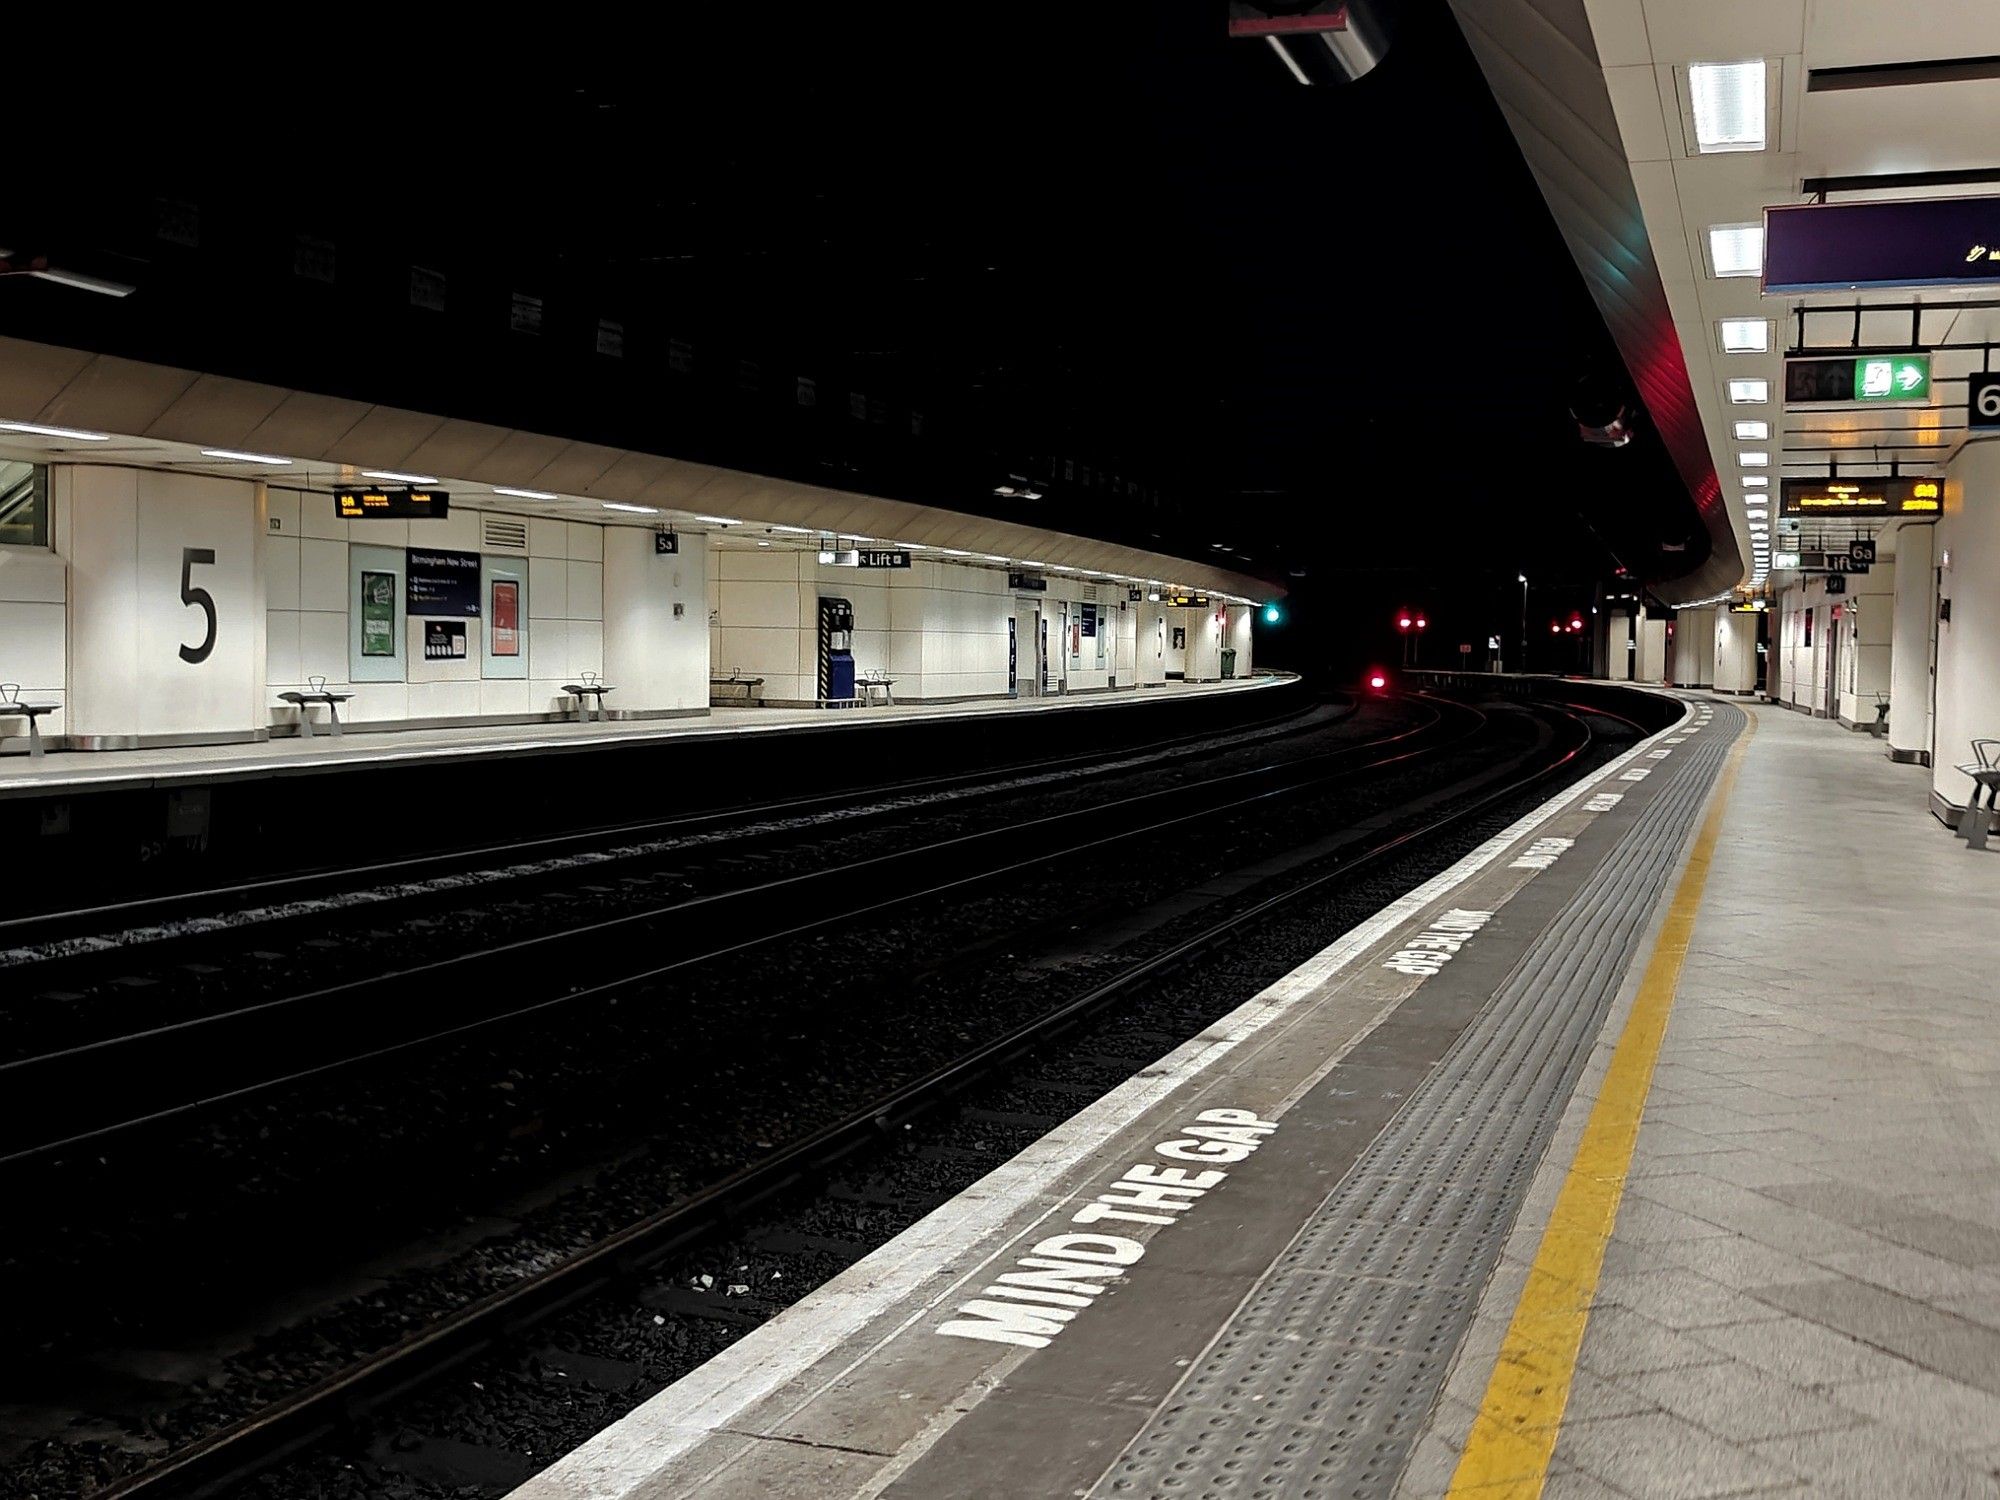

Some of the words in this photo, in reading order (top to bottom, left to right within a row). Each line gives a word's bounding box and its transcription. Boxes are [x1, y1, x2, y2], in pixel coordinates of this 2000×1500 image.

[659, 537, 673, 550] 5a
[1853, 546, 1873, 560] 6a
[869, 553, 891, 566] Lift
[179, 547, 217, 665] 5
[1405, 931, 1474, 954] THE
[1381, 950, 1453, 975] GAP
[935, 1233, 1146, 1349] MIND
[1071, 1163, 1230, 1226] THE
[1154, 1108, 1280, 1163] GAP
